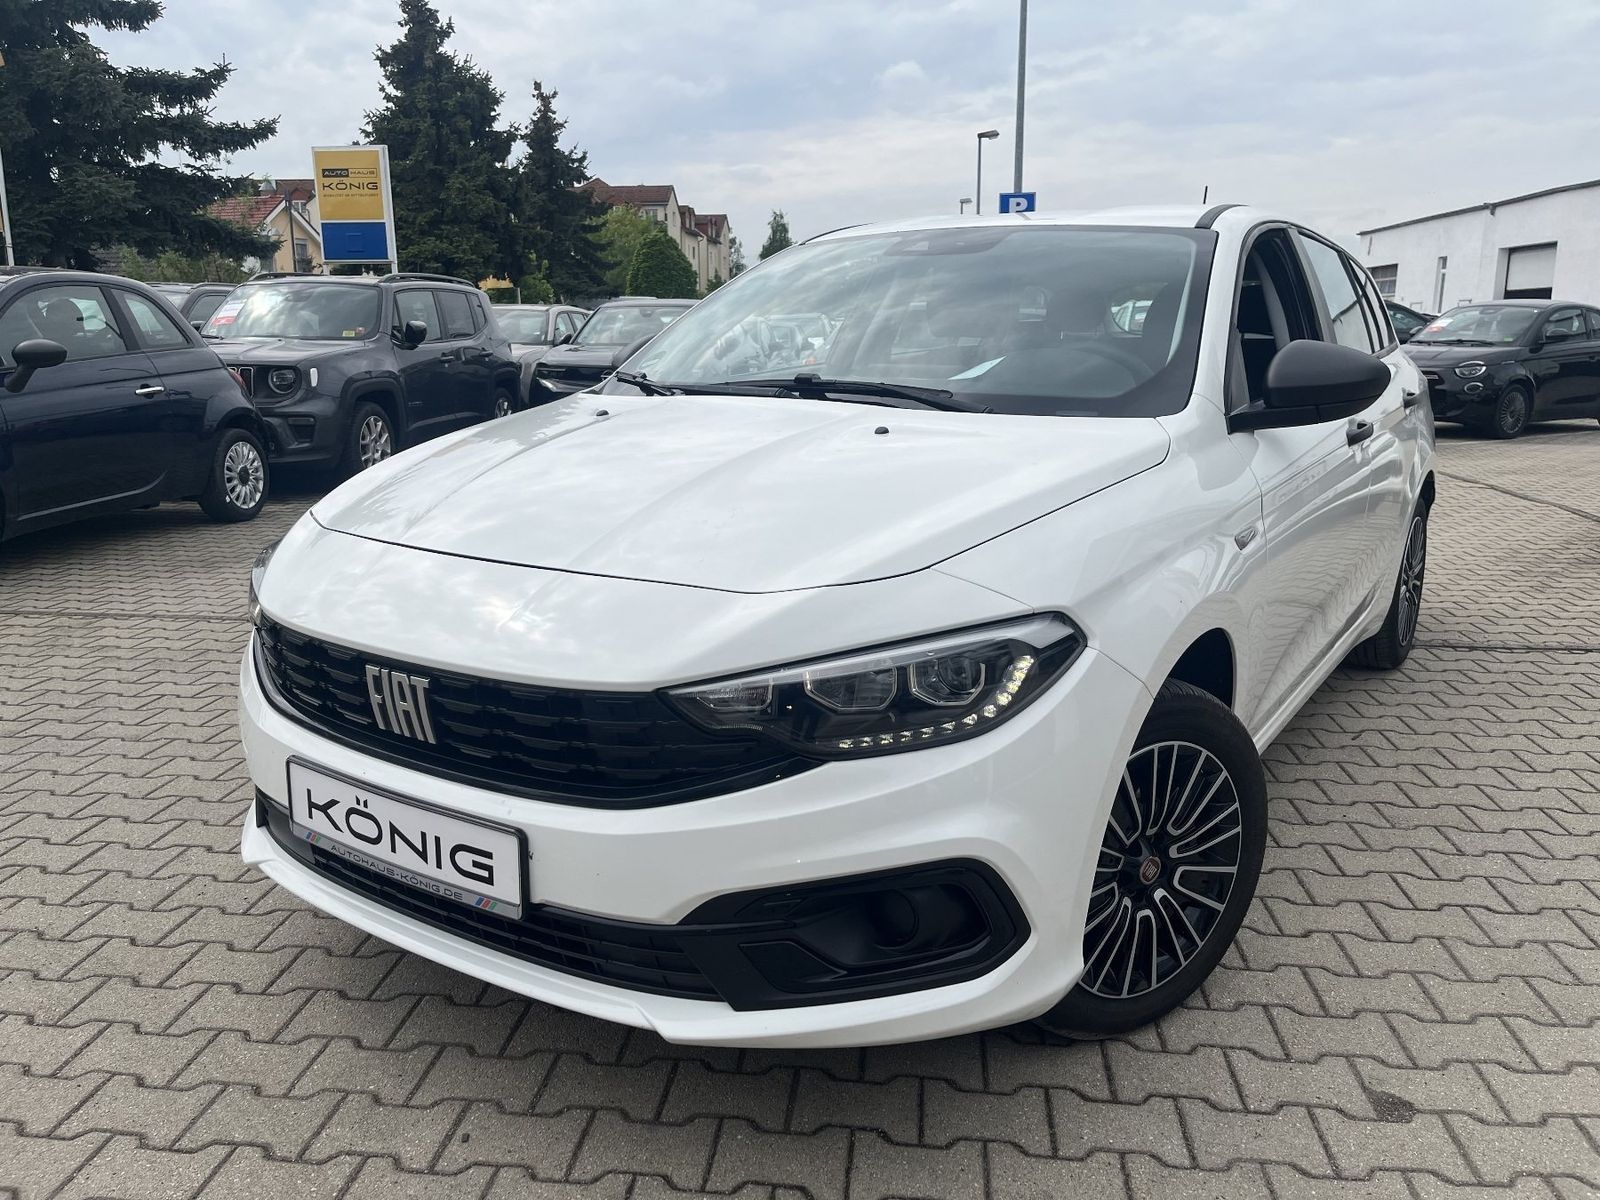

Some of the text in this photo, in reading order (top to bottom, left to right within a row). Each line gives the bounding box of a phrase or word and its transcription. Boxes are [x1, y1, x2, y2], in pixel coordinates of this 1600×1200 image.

[322, 180, 378, 190] KÖNIG
[1009, 197, 1028, 213] P
[365, 664, 437, 744] FIAT
[306, 788, 495, 887] KÖNIG
[330, 844, 464, 901] AUTOHAUS-KÖNIG.DE
